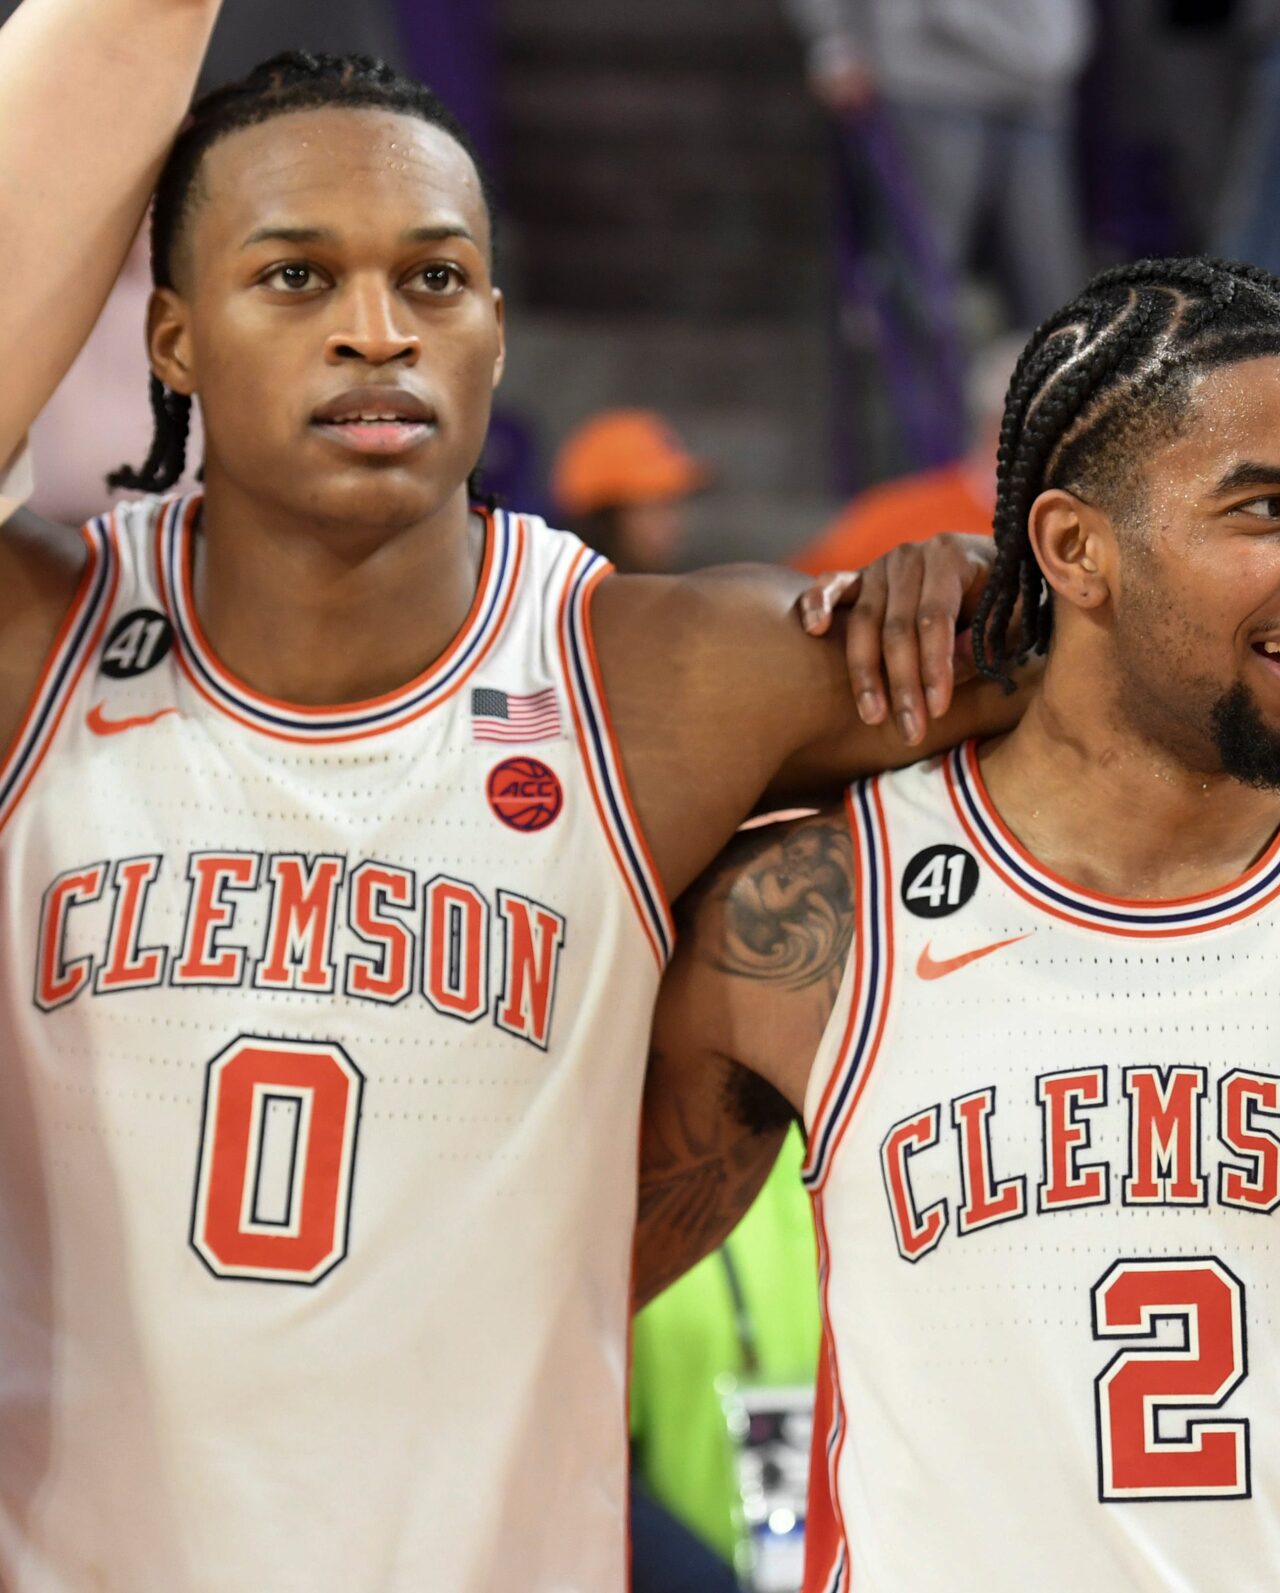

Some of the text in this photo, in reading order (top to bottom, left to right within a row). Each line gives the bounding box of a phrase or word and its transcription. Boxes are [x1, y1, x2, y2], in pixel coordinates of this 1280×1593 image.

[103, 619, 162, 668] 41
[500, 779, 553, 798] ACC
[907, 854, 964, 908] 41
[33, 850, 565, 1051] CLEMSON
[189, 1034, 364, 1286] 0
[1090, 1256, 1252, 1503] 2
